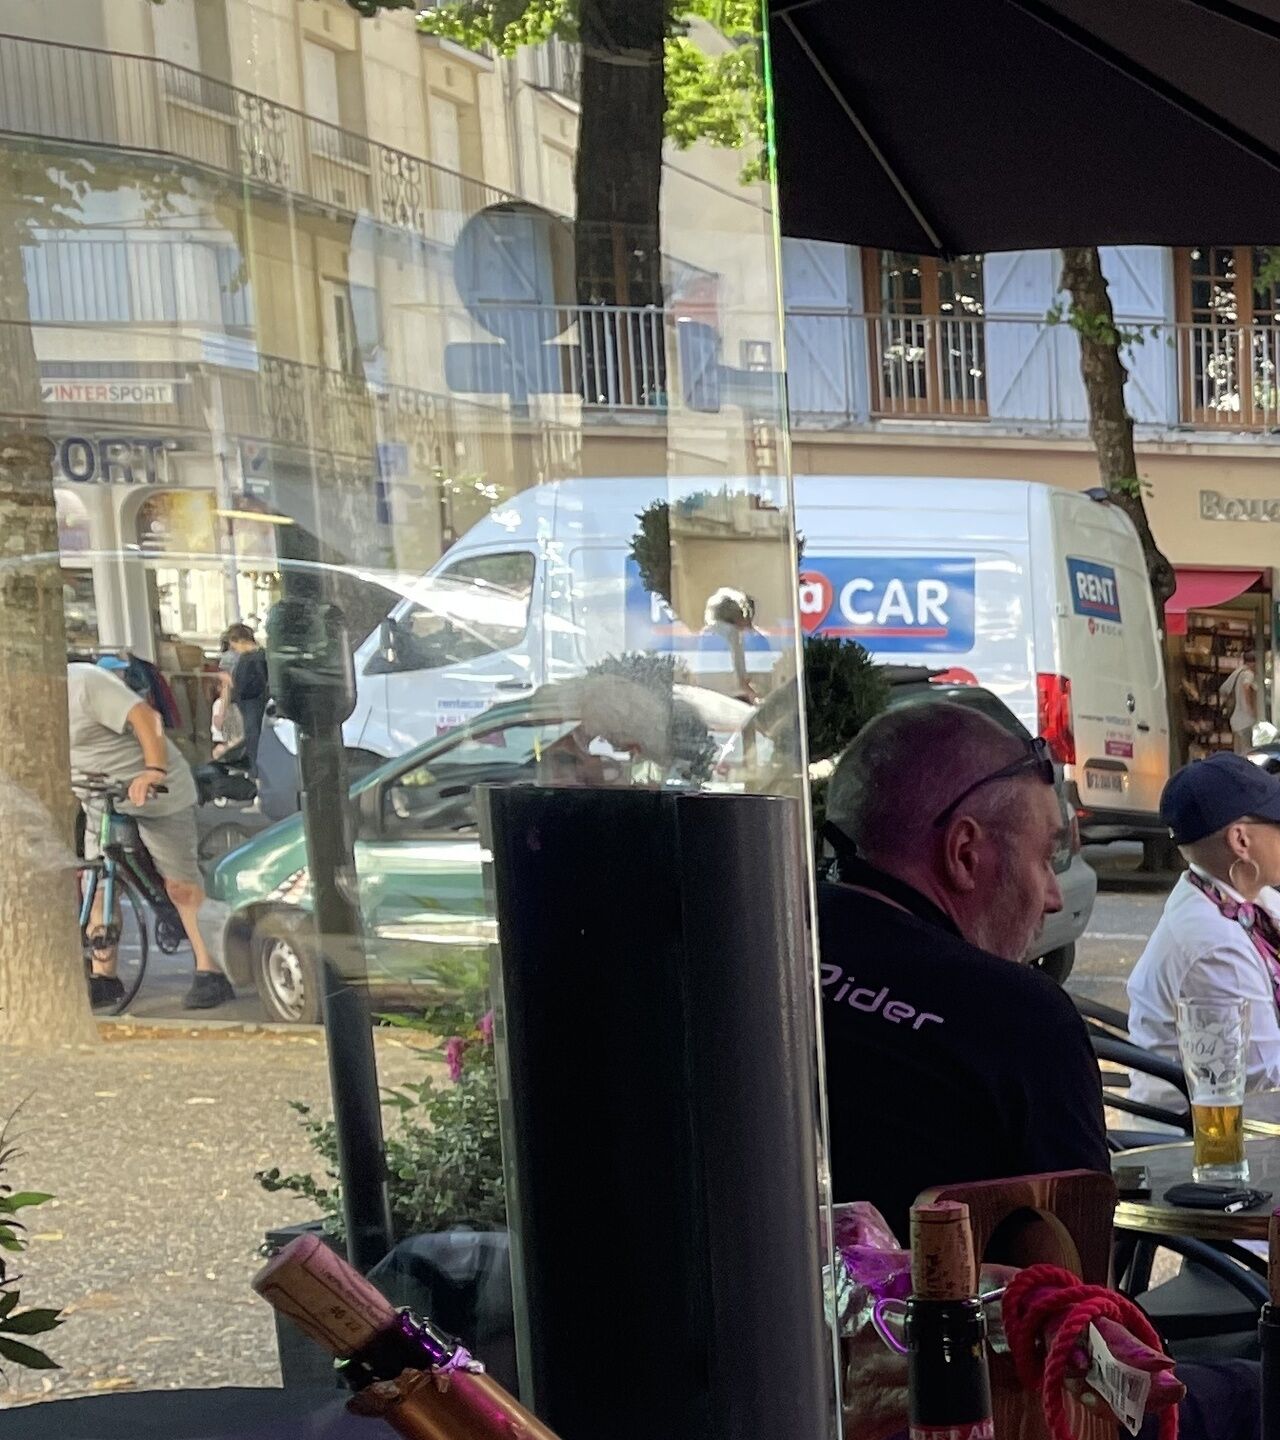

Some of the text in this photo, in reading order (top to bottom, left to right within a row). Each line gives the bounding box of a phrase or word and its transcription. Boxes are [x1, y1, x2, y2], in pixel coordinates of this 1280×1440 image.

[55, 385, 167, 400] INTERSPORT
[61, 437, 163, 483] ORT
[839, 578, 951, 626] CAR
[1075, 571, 1115, 606] RENT
